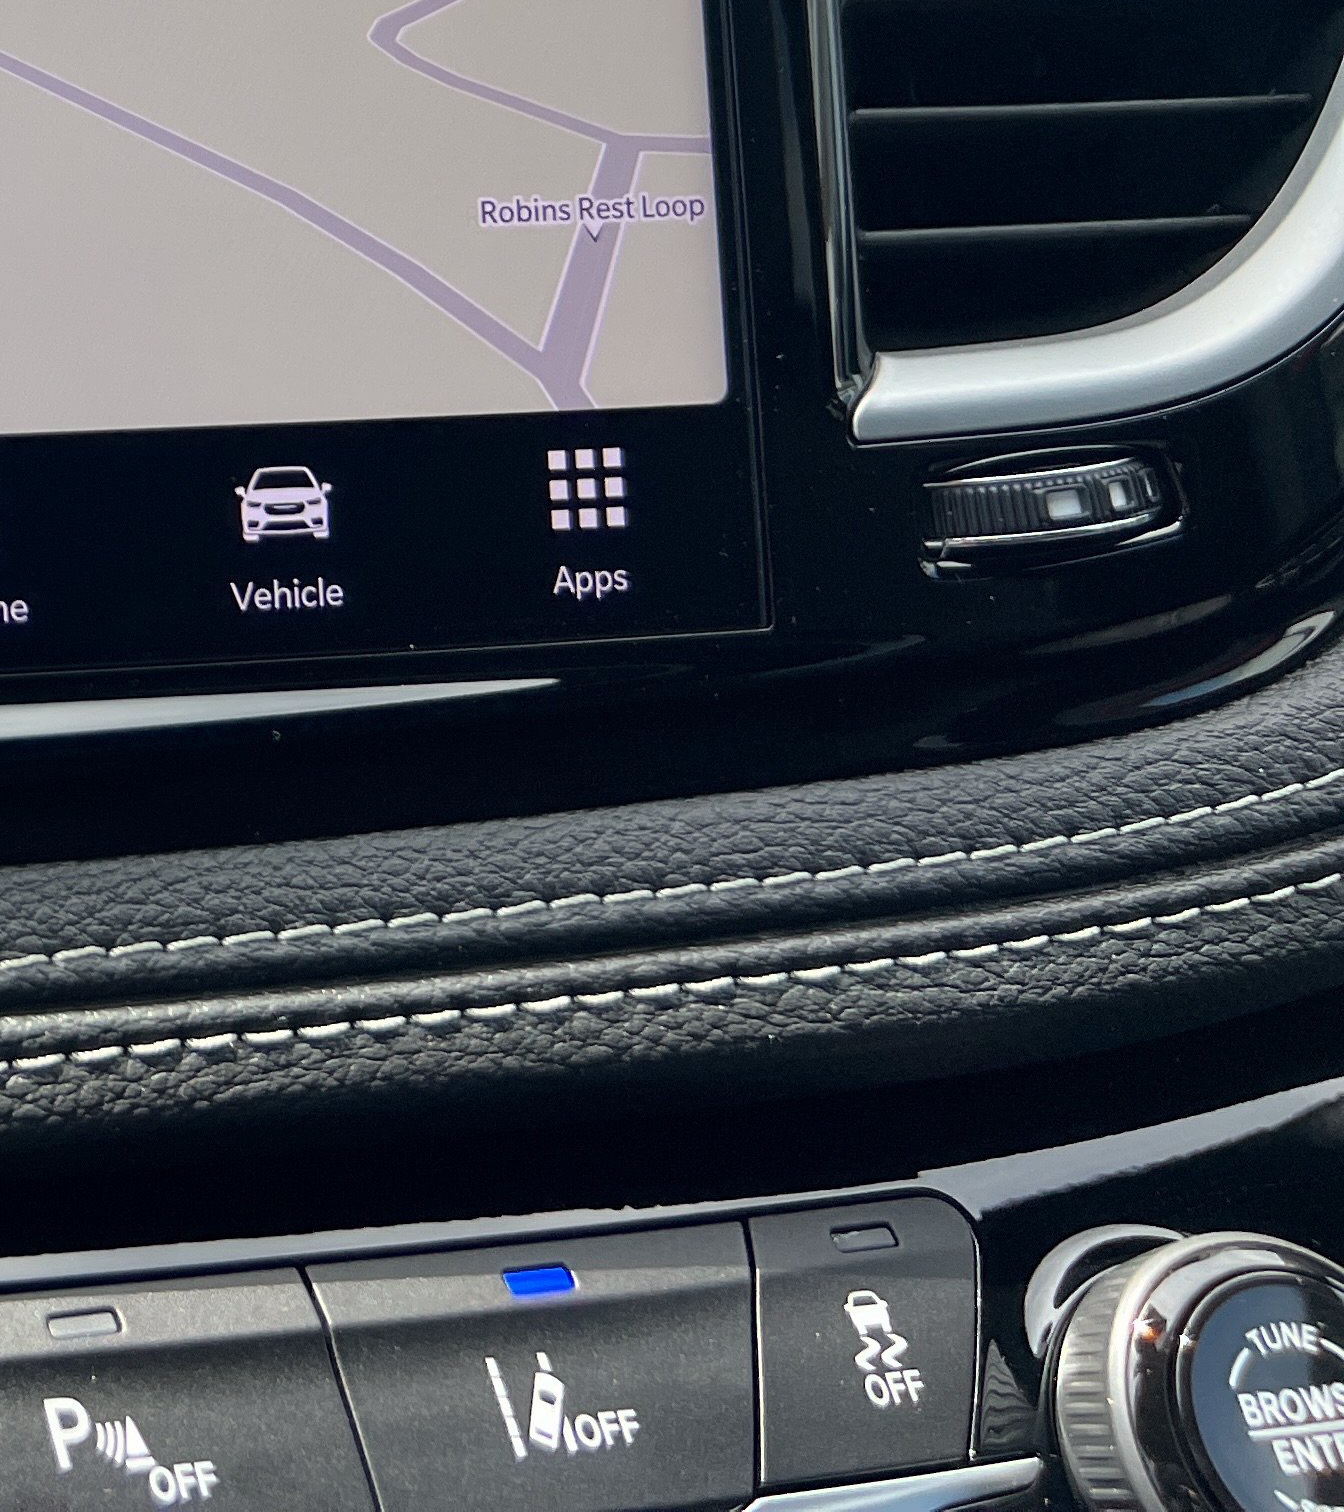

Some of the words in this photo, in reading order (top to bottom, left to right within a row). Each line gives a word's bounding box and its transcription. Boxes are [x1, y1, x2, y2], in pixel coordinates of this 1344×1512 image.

[480, 199, 571, 224] Robins
[578, 197, 635, 221] Rest
[641, 195, 705, 221] Loop
[231, 578, 345, 612] Vehicle
[553, 566, 629, 601] Apps
[1245, 1321, 1320, 1356] TUNE
[864, 1369, 924, 1409] OFF
[575, 1408, 640, 1450] OFF
[148, 1460, 218, 1506] OFF
